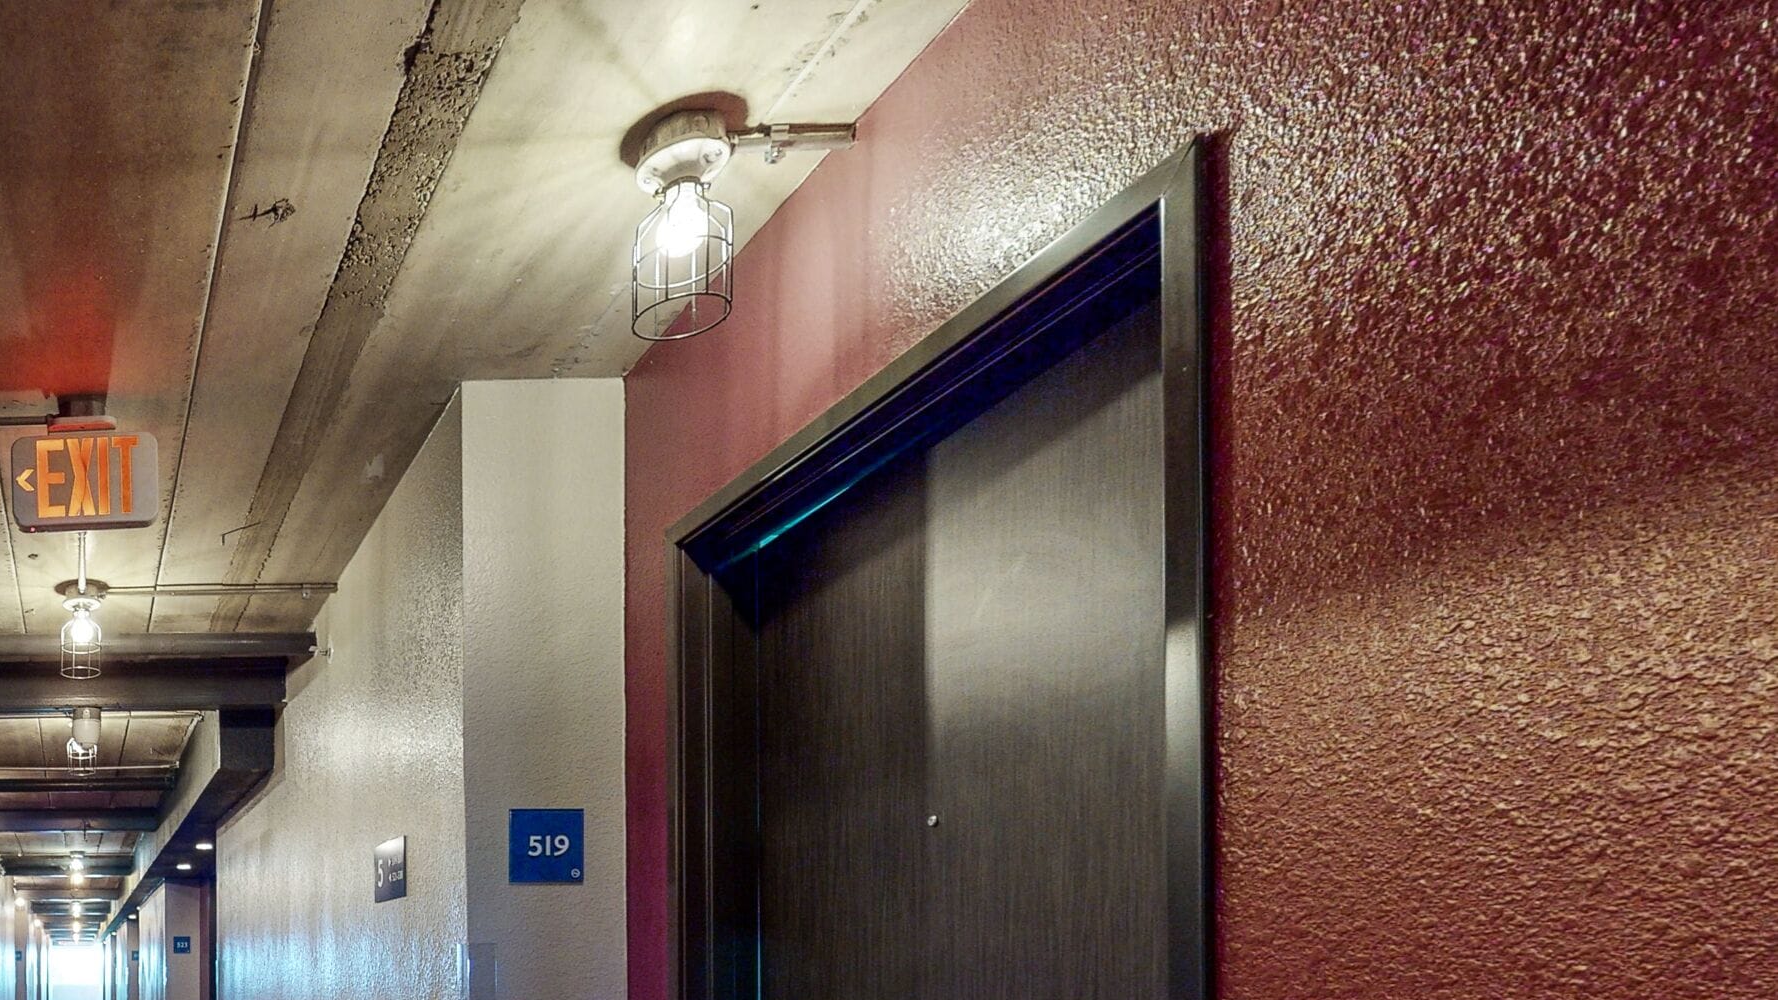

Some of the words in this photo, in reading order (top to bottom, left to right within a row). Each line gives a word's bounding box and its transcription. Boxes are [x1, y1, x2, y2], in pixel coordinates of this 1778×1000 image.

[36, 437, 139, 518] EXIT
[527, 834, 570, 857] 519
[377, 859, 384, 888] 5
